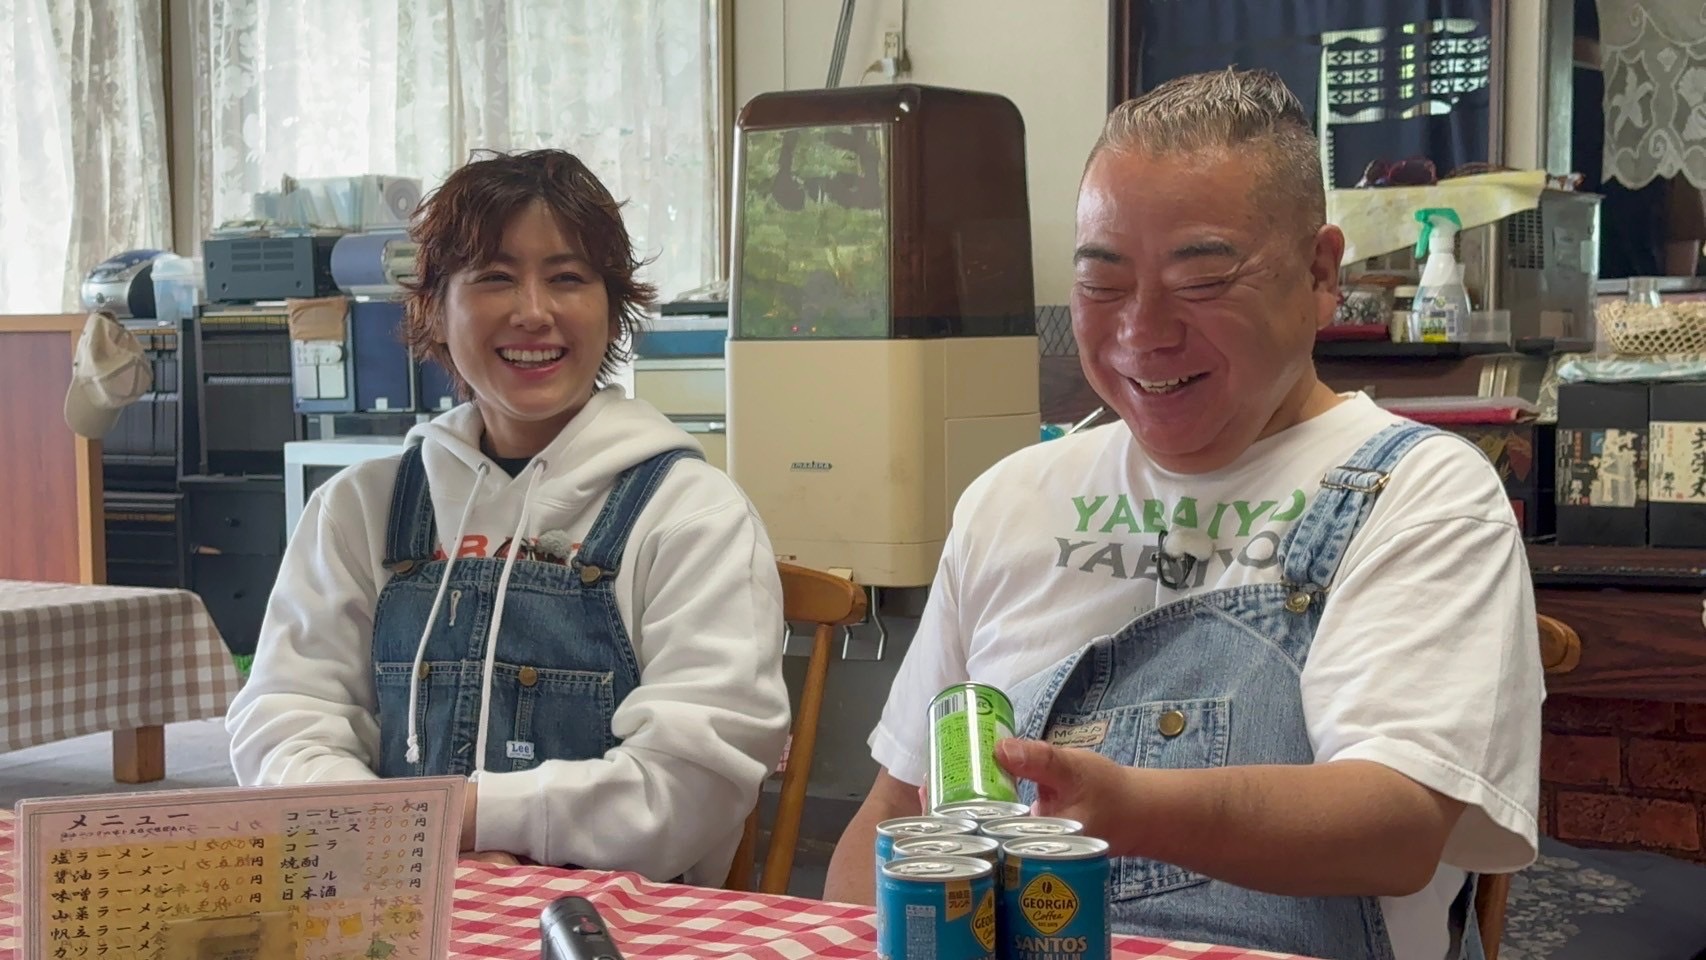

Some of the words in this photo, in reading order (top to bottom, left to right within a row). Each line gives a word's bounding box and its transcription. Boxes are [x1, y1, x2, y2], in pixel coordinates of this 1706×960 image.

[511, 743, 530, 753] Lee
[68, 813, 190, 830] メニュー
[287, 808, 362, 821] コーヒー
[286, 823, 361, 838] ジュース
[285, 839, 338, 852] コーラ
[366, 832, 425, 846] 200円
[51, 847, 155, 865] 塩ラーメン
[280, 855, 319, 869] 焼酎
[54, 865, 175, 885] 醤油ラーメン
[284, 871, 337, 884] ビール
[51, 883, 174, 903] 味噌ラーメン
[282, 885, 337, 900] 日本酒
[51, 901, 174, 920] 山菜ラーメン
[1023, 898, 1074, 910] GEORGIA
[1033, 911, 1064, 921] Coffee
[1015, 935, 1088, 953] SANTOS
